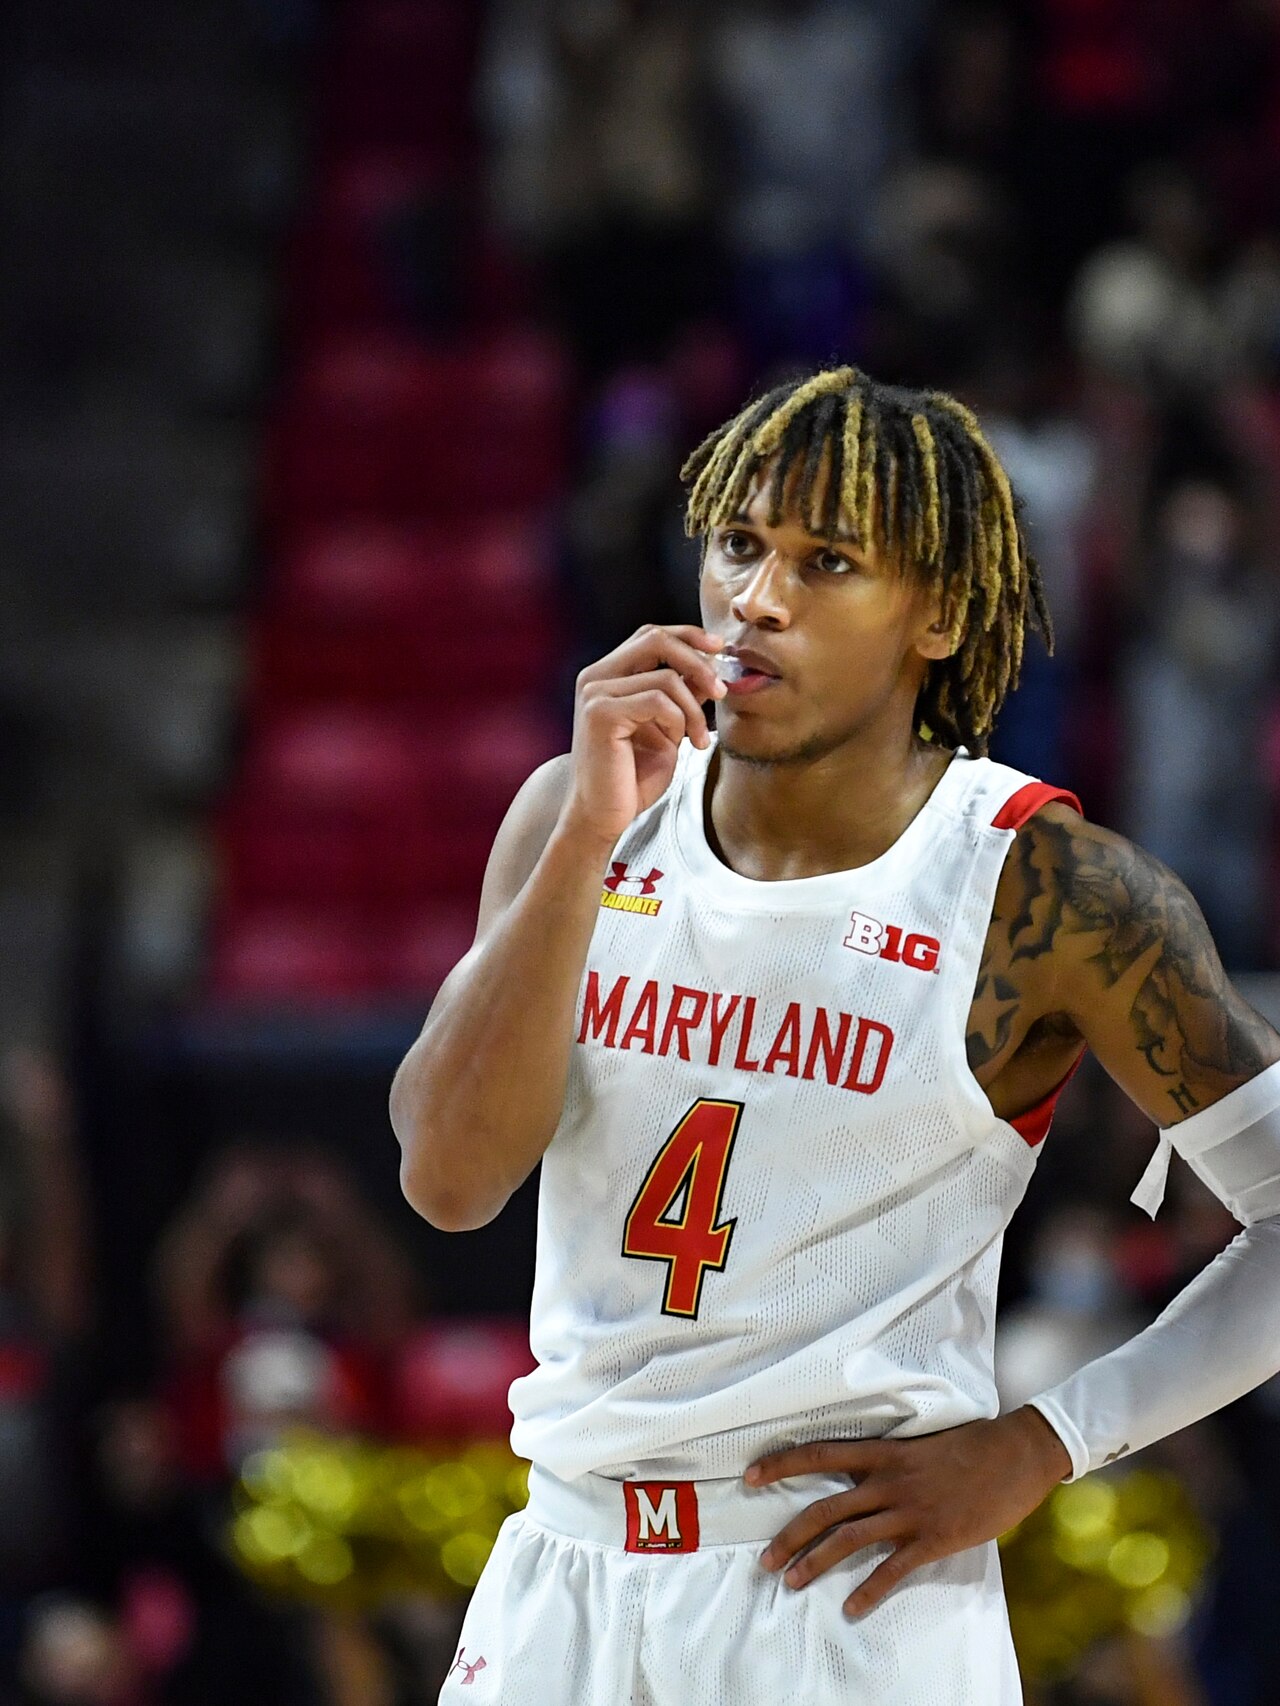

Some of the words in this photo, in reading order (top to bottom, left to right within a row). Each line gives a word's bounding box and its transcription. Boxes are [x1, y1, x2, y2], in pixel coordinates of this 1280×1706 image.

[600, 890, 661, 916] RADUATE
[577, 971, 894, 1094] MARYLAND
[621, 1097, 744, 1320] 4
[633, 1486, 682, 1540] M
